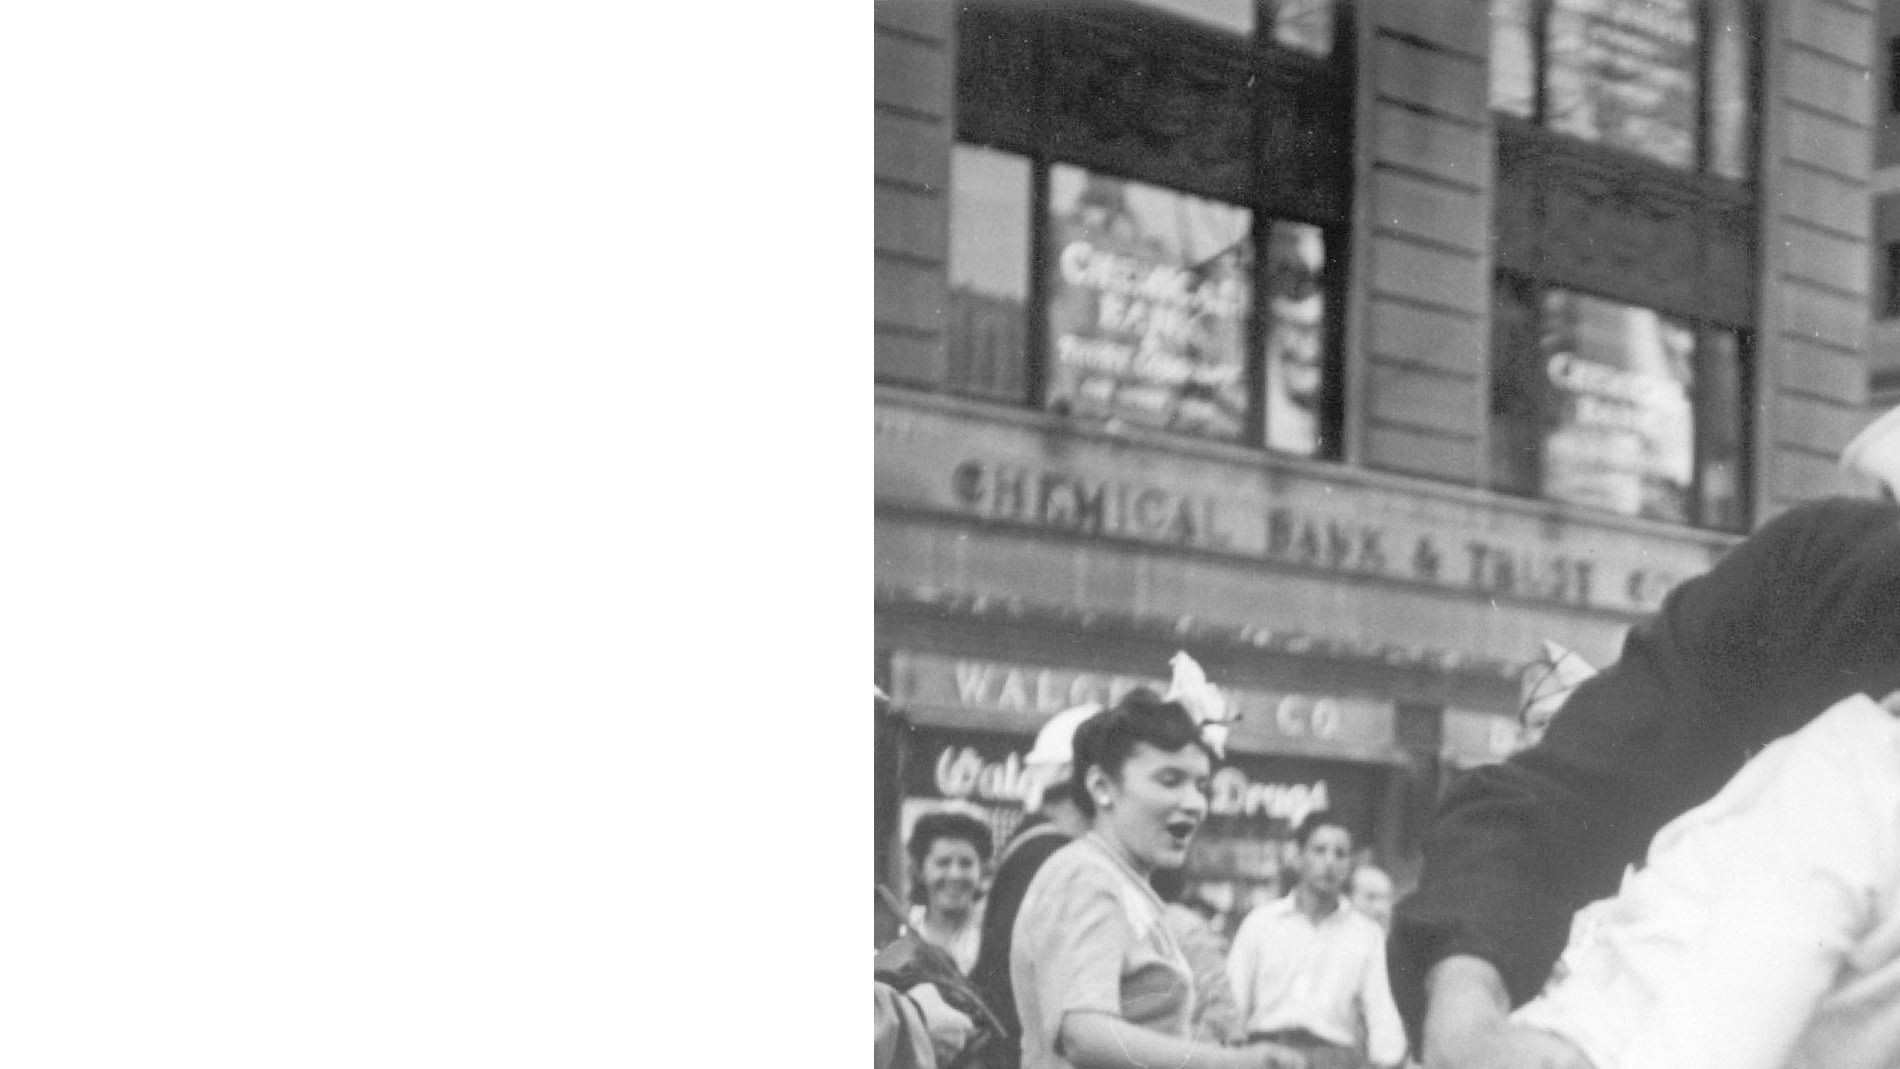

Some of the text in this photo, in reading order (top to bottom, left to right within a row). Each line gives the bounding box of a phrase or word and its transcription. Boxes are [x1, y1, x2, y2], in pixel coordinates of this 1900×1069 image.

[952, 457, 1234, 547] CHEMICAL
[1266, 503, 1389, 571] BANK
[1411, 531, 1442, 579] &
[1466, 542, 1596, 600] TRUST
[1276, 695, 1344, 736] CO
